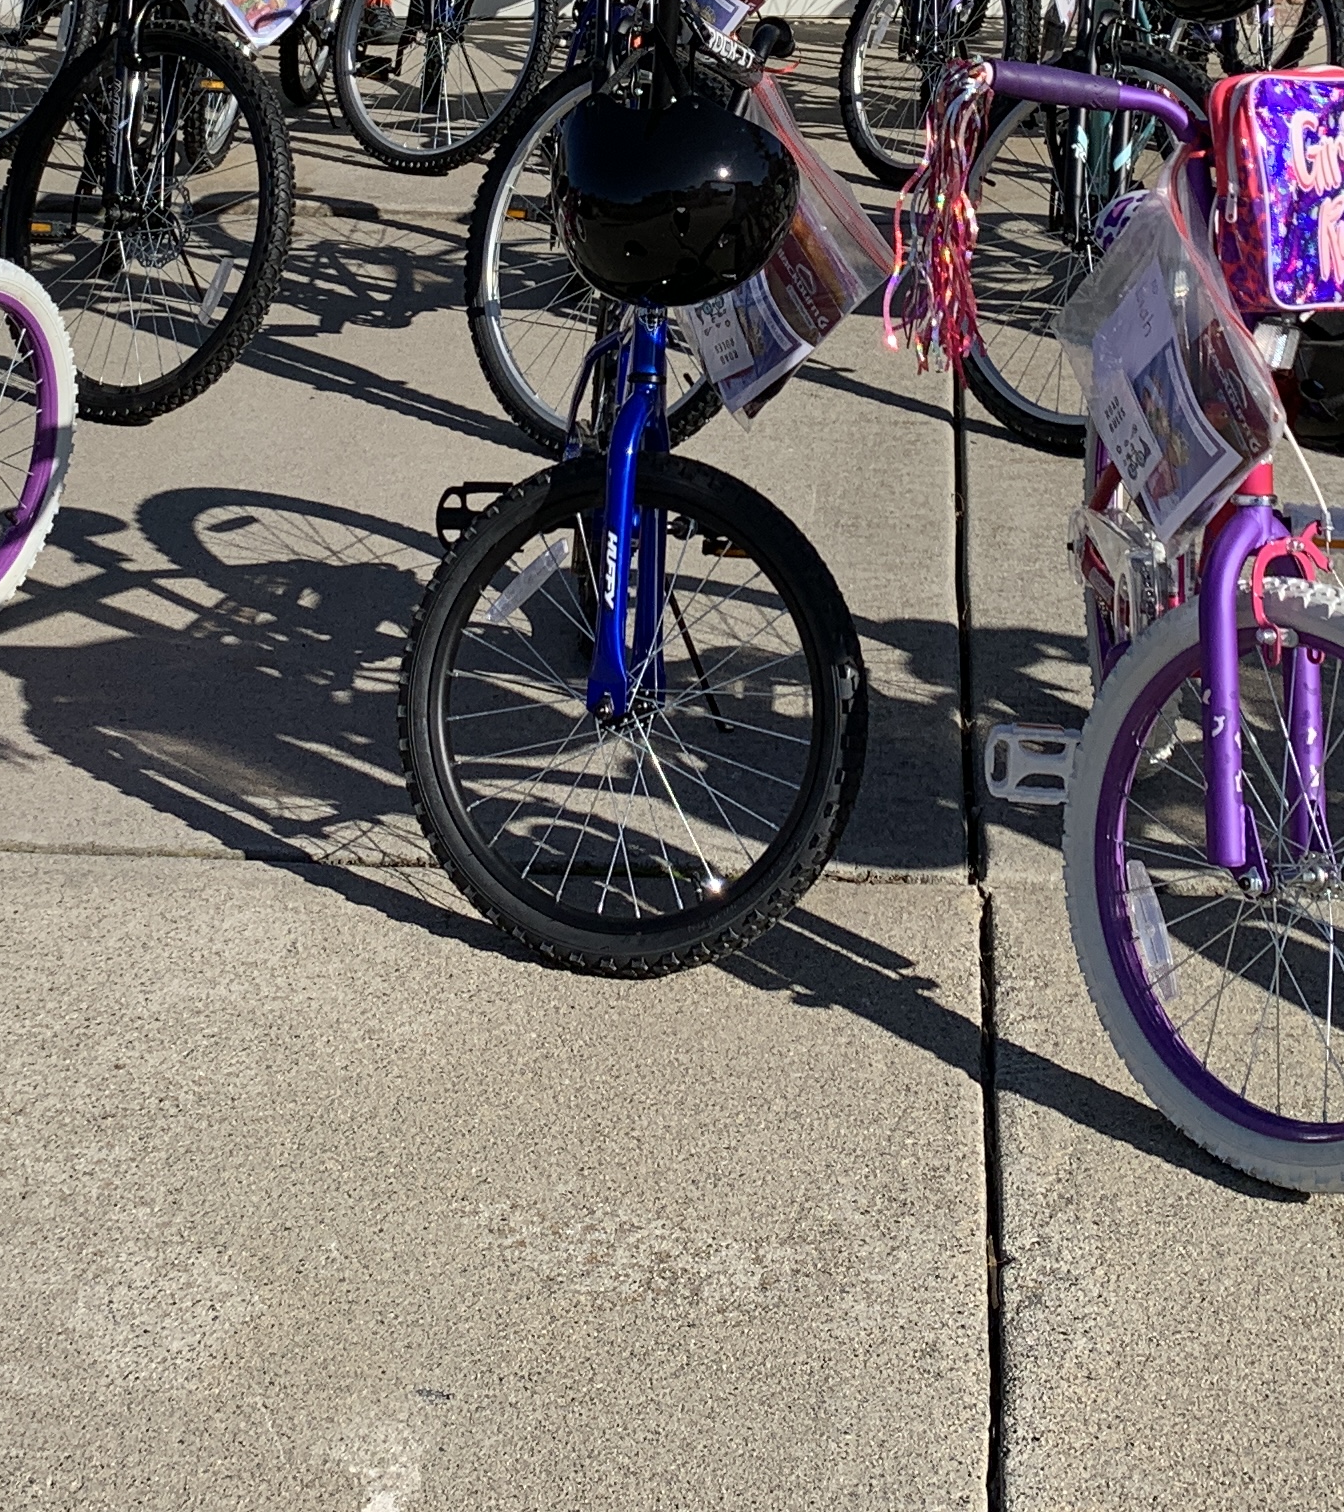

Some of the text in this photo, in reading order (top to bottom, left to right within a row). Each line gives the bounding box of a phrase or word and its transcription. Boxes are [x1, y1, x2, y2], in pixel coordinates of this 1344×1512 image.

[714, 338, 736, 354] RULES
[719, 348, 739, 366] ROAD
[1104, 395, 1120, 421] ROAD
[1108, 408, 1127, 436] RULES
[604, 530, 618, 610] HUFFY
